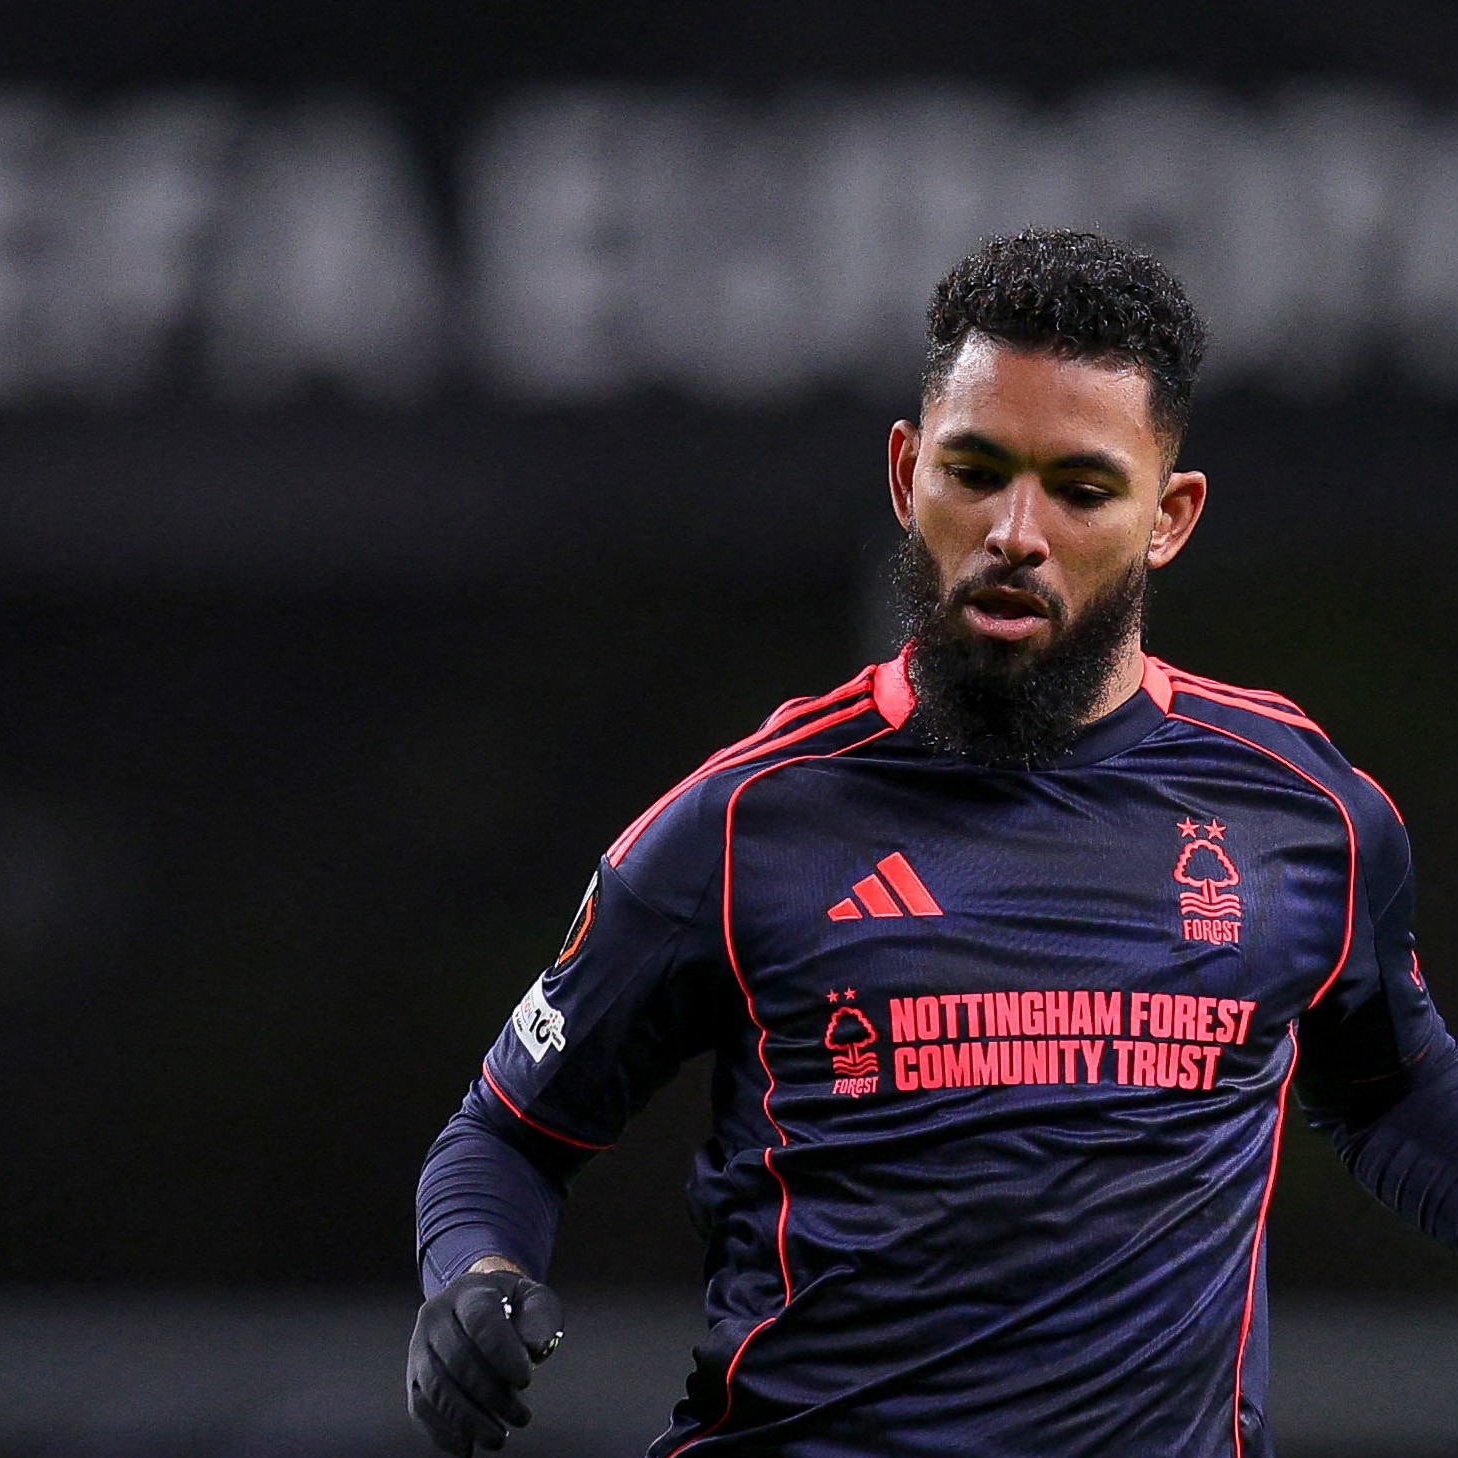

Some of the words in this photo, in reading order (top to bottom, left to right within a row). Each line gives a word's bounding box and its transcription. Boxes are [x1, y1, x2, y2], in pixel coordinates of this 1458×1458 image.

[889, 991, 1132, 1043] NOTTINGHAM
[1133, 991, 1257, 1046] FOREST
[894, 1039, 1104, 1091] COMMUNITY
[1113, 1040, 1224, 1091] TRUST
